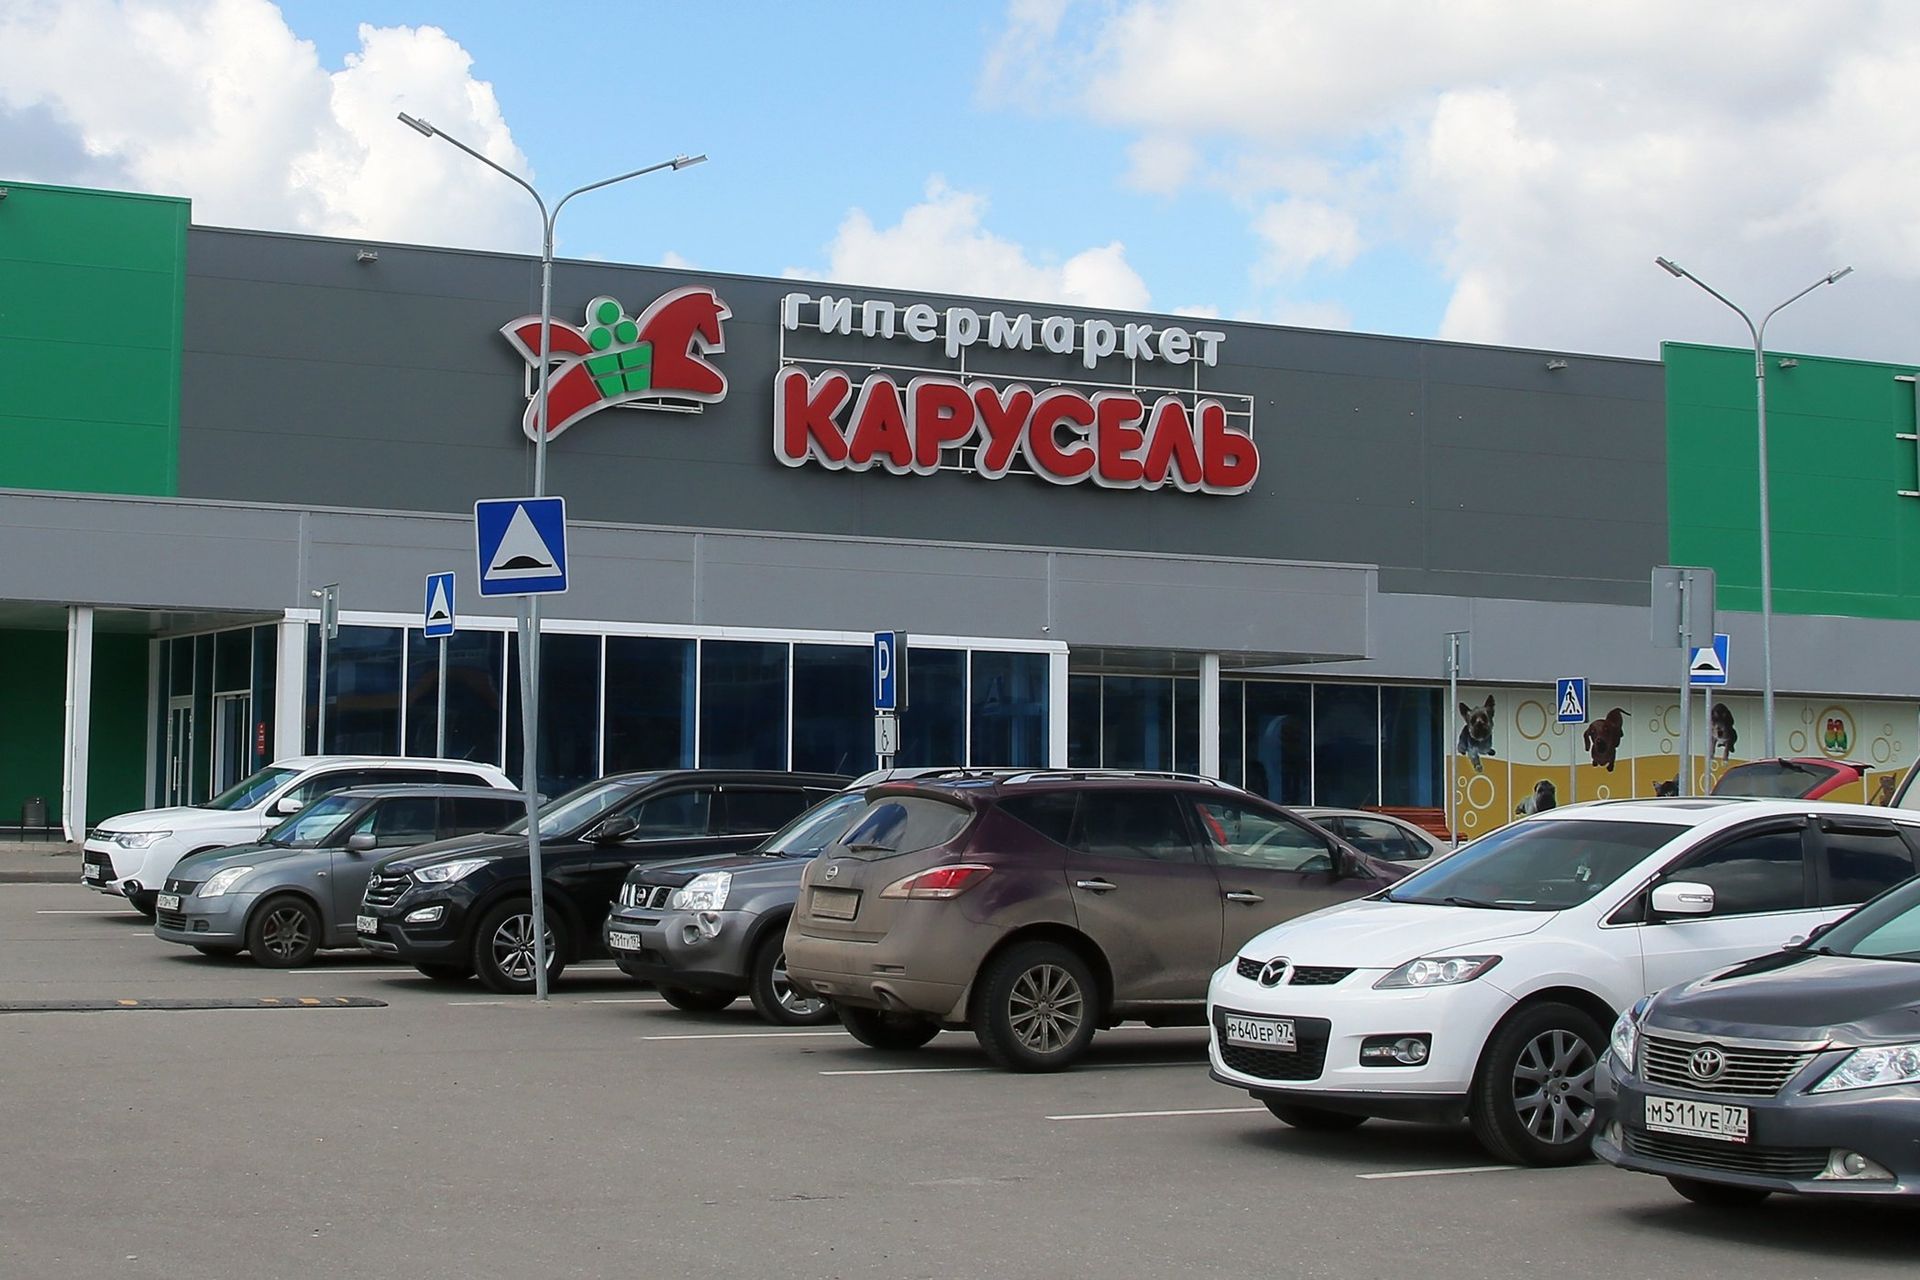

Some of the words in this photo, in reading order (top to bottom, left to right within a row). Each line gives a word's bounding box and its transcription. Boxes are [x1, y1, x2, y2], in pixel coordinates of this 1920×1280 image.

[785, 293, 1225, 367] гипермаркет
[775, 367, 1260, 496] КАРУСЕЛЬ
[878, 641, 890, 700] P
[1651, 1101, 1720, 1129] М511УЕ
[1724, 1107, 1742, 1126] 77
